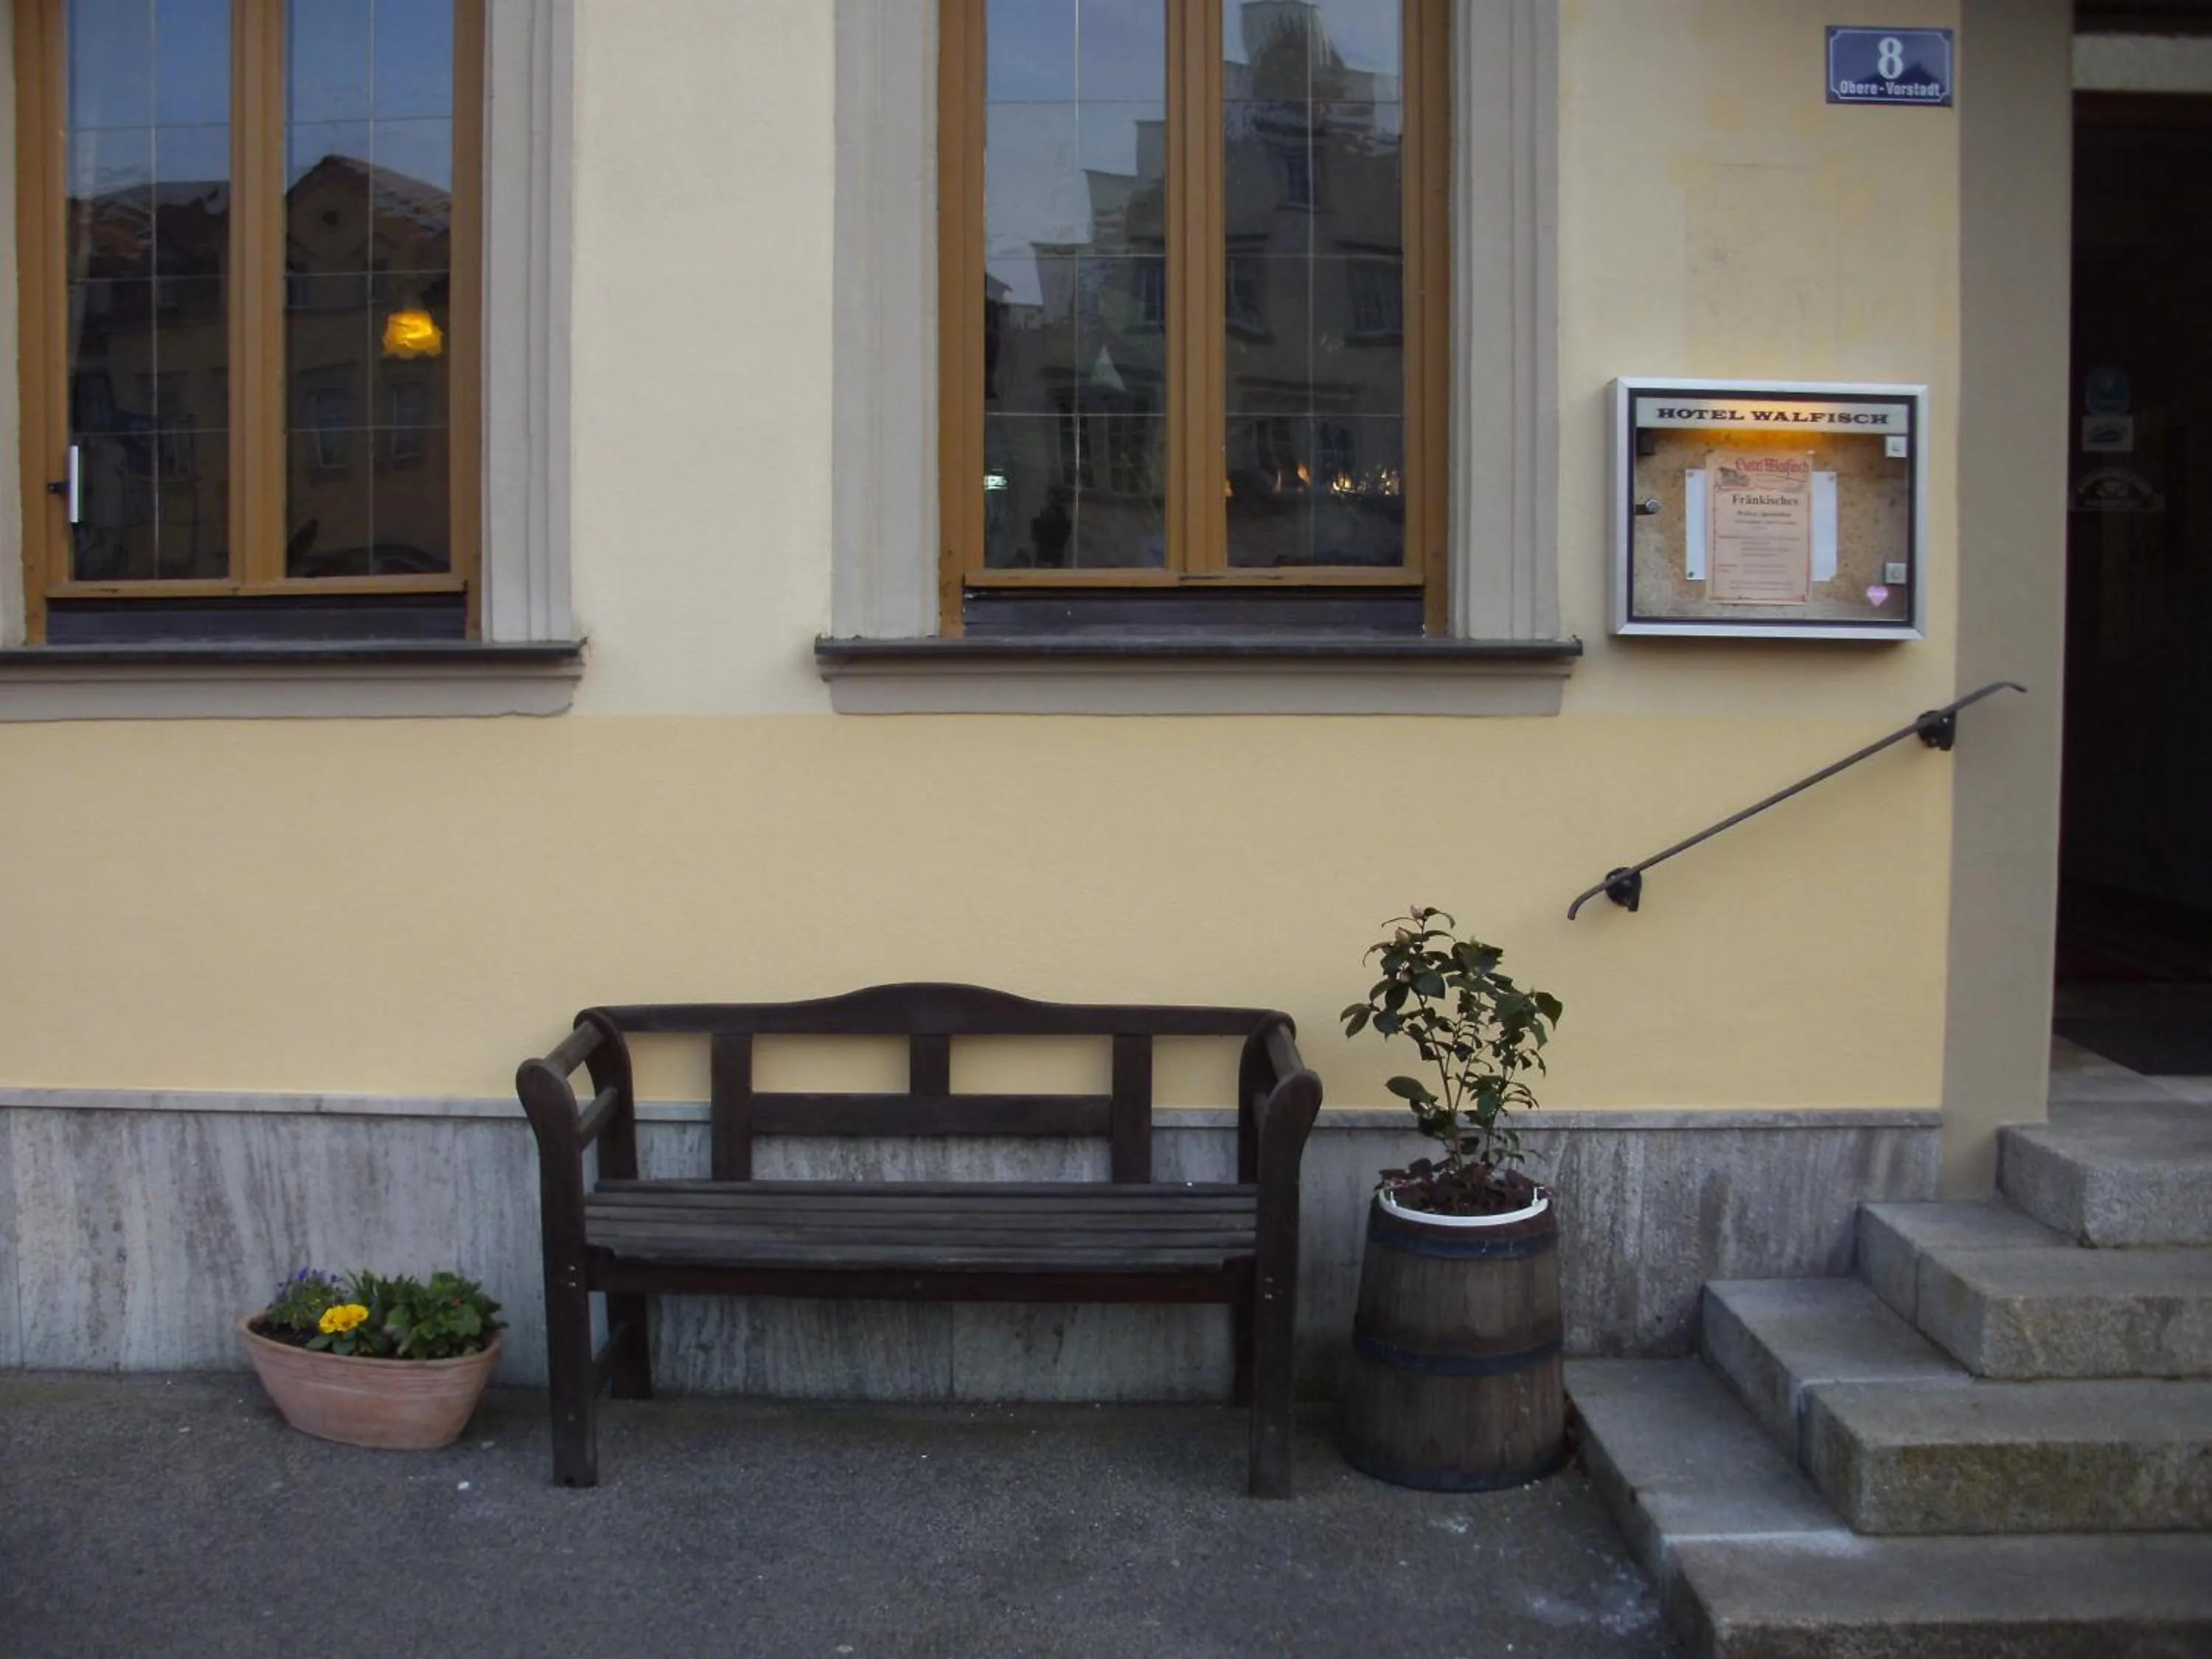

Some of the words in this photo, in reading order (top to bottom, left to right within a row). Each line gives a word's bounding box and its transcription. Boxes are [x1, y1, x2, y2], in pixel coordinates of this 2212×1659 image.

[1877, 37, 1904, 80] 8
[1656, 407, 1745, 421] HOTEL
[1751, 410, 1889, 425] WALFISCH
